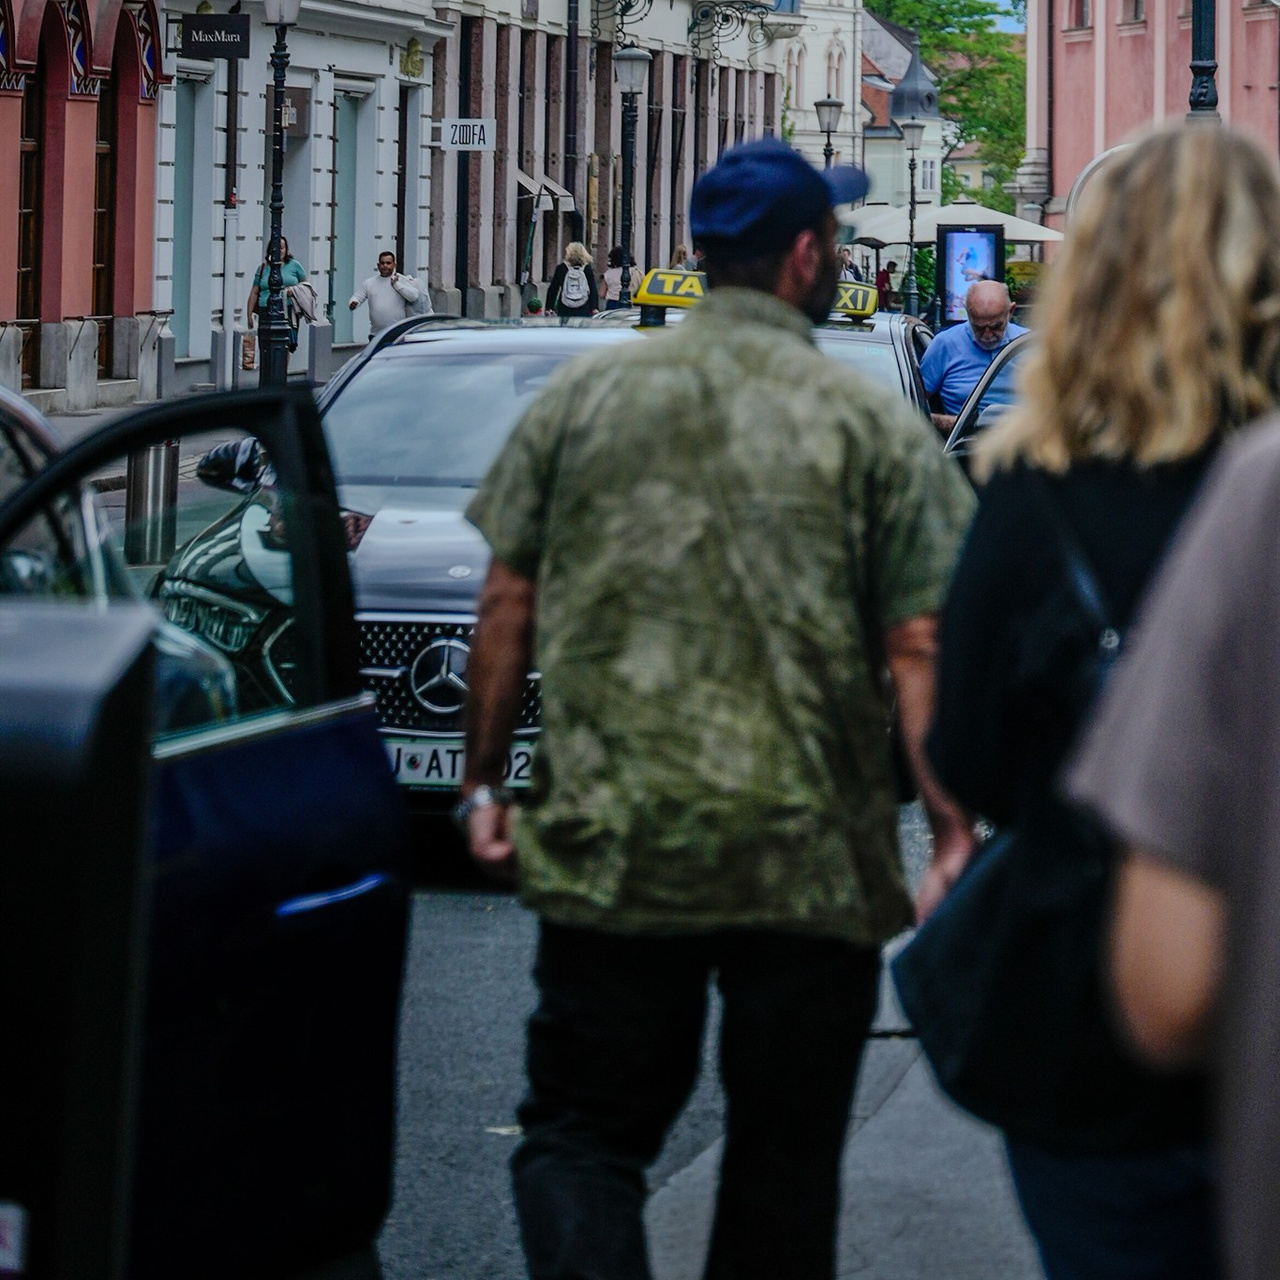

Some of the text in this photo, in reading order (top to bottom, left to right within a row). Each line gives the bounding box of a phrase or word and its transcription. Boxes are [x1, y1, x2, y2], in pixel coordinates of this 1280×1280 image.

[191, 29, 241, 43] MaxMara
[657, 273, 705, 297] TA
[834, 287, 864, 310] XI
[425, 748, 464, 778] AT
